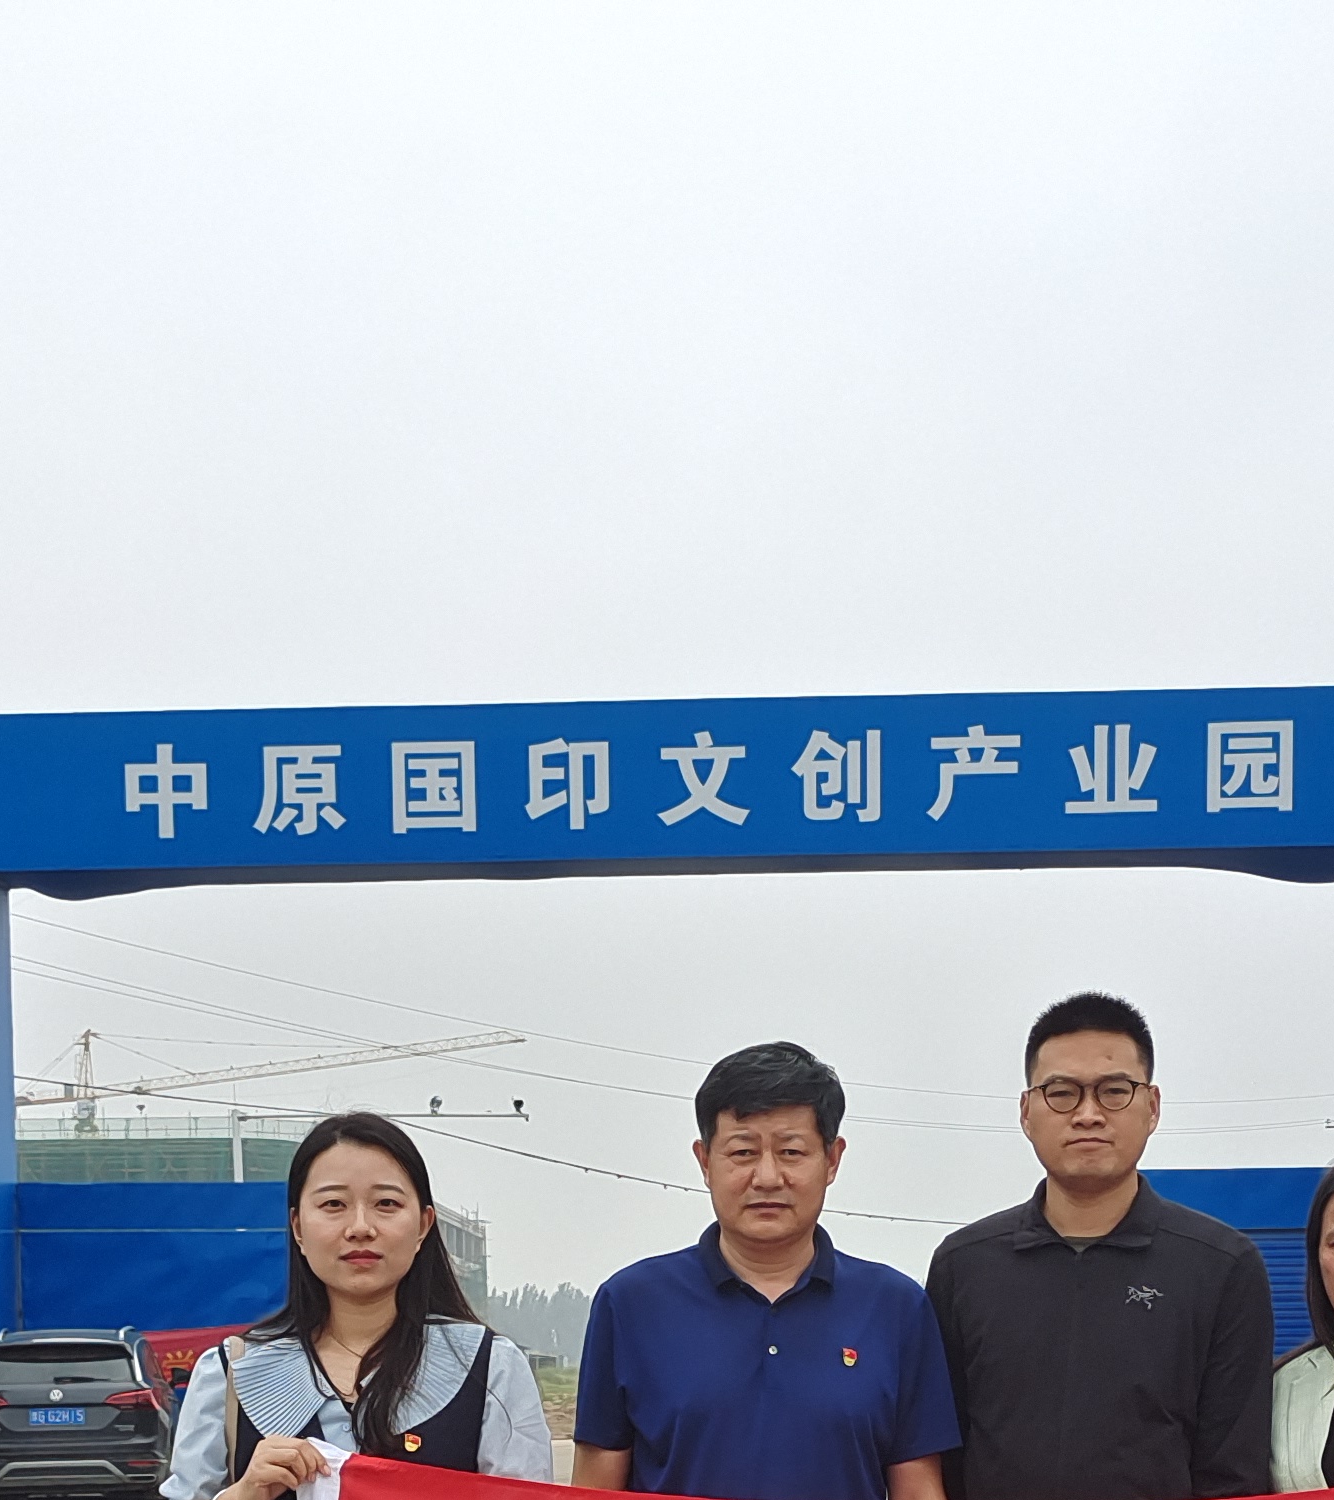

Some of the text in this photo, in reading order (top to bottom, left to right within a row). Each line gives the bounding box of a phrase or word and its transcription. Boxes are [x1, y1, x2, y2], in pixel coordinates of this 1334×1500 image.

[123, 720, 1295, 838] 中原国印文创产业园
